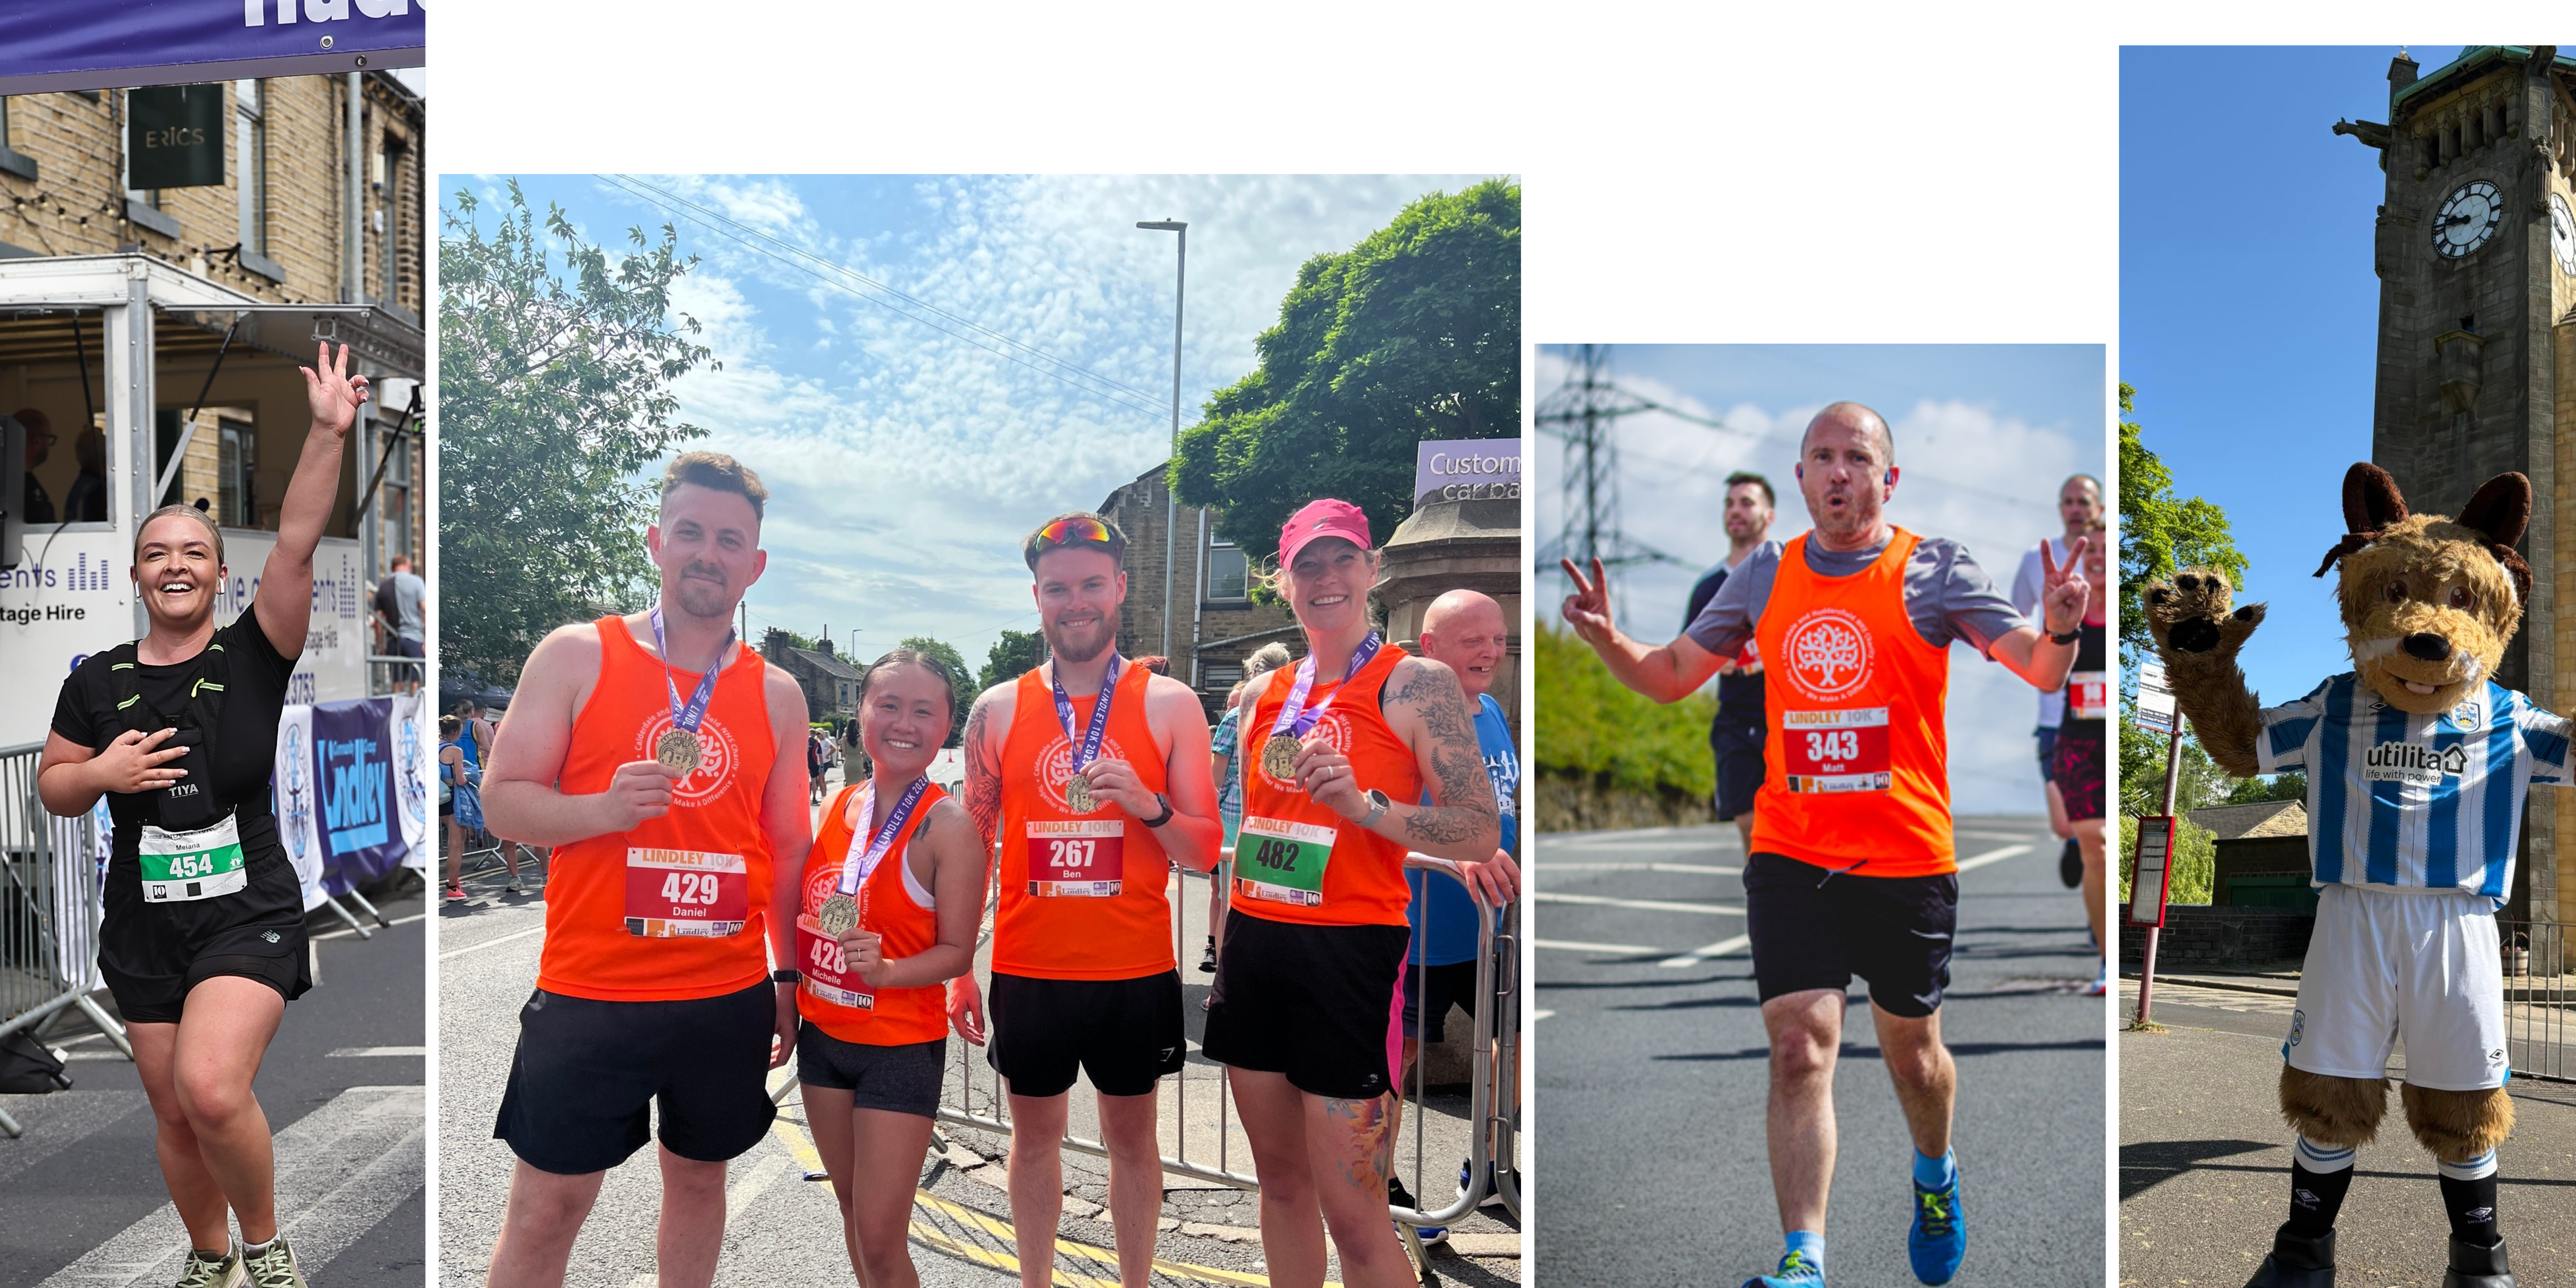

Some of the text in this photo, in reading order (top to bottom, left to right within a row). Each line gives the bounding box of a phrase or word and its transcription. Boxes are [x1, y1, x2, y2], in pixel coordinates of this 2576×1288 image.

[1443, 483, 1483, 500] car
[47, 604, 85, 620] Hire
[1790, 710, 1872, 724] LINDLEY 10K
[634, 707, 670, 751] Calderdale and
[1082, 687, 1111, 765] LINDLEY 10K 2023
[1338, 713, 1353, 752] NHS Charity
[662, 731, 691, 744] LINDLEY
[1108, 738, 1121, 751] NHS
[1807, 731, 1859, 761] 343
[720, 727, 740, 771] NHS Charity
[1033, 735, 1063, 776] Calderdale and
[2368, 745, 2441, 771] utilita
[1822, 763, 1845, 772] Matt
[2365, 769, 2441, 783] life with power
[168, 783, 199, 796] TIYA
[673, 798, 695, 808] Make
[702, 779, 733, 806] Difference
[1274, 782, 1284, 791] We
[1038, 784, 1058, 809] Together
[1058, 805, 1069, 814] We
[1097, 799, 1112, 810] Diffe
[878, 808, 905, 845] LINDLEY
[902, 792, 916, 809] 10K
[1033, 821, 1111, 833] LINDLEY 10K
[1297, 824, 1320, 838] 10K
[642, 849, 733, 867] LINDLEY 10K
[1050, 840, 1096, 867] 267
[1256, 840, 1300, 872] 482
[169, 853, 213, 878] 454
[818, 861, 830, 871] and
[153, 886, 166, 896] 10
[213, 878, 240, 891] ERICS
[662, 872, 719, 905] 429
[1110, 882, 1120, 892] 10
[824, 896, 851, 907] LINDLEY
[861, 889, 869, 916] Charity
[1262, 890, 1288, 902] Lindley
[1308, 893, 1320, 904] 10
[673, 907, 706, 917] Daniel
[677, 927, 709, 937] Lindley
[729, 922, 742, 932] 10
[803, 915, 824, 932] LIND
[810, 938, 847, 974] 428
[812, 967, 842, 986] Michelle
[816, 988, 839, 1003] Lindley
[858, 995, 871, 1006] 10
